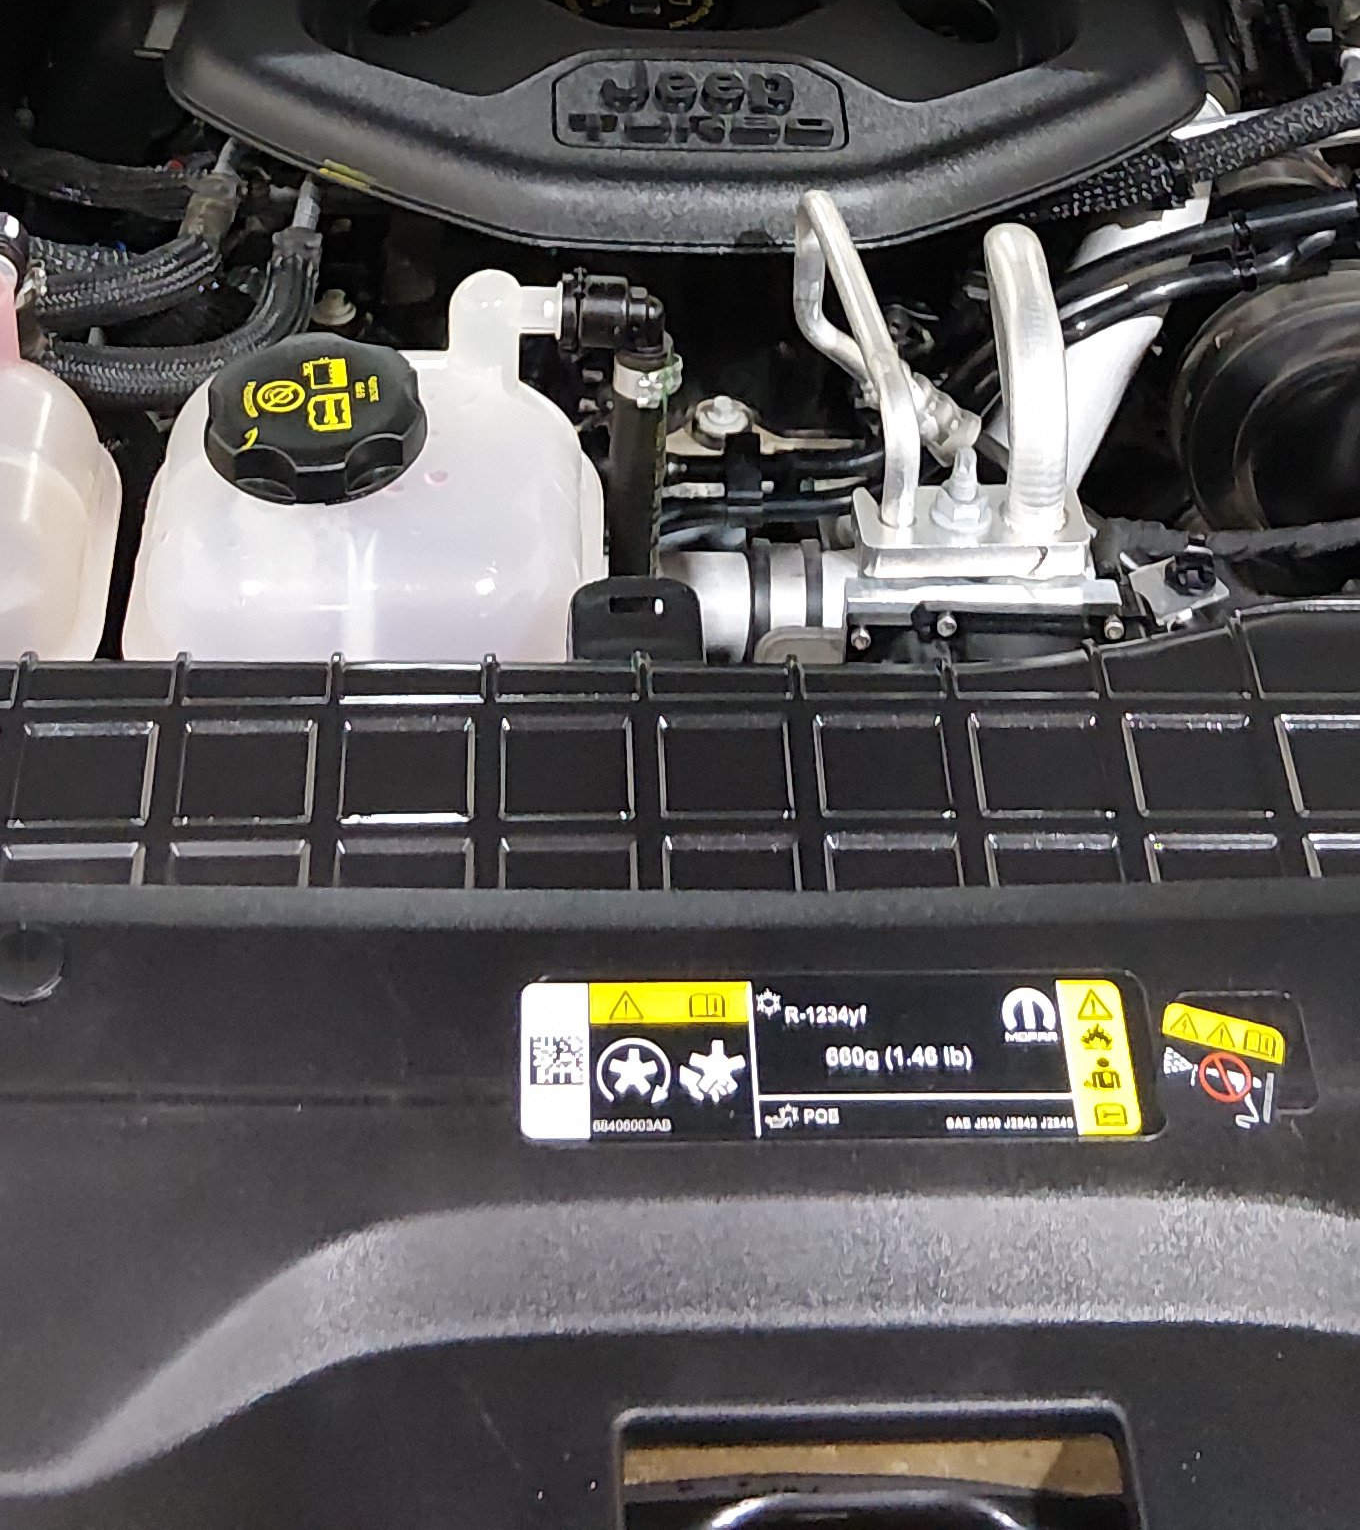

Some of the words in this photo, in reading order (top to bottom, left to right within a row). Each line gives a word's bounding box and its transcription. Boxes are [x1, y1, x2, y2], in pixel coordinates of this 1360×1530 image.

[600, 60, 795, 116] Jeep
[784, 1004, 868, 1028] R-1234yf
[943, 1045, 973, 1071] lb)
